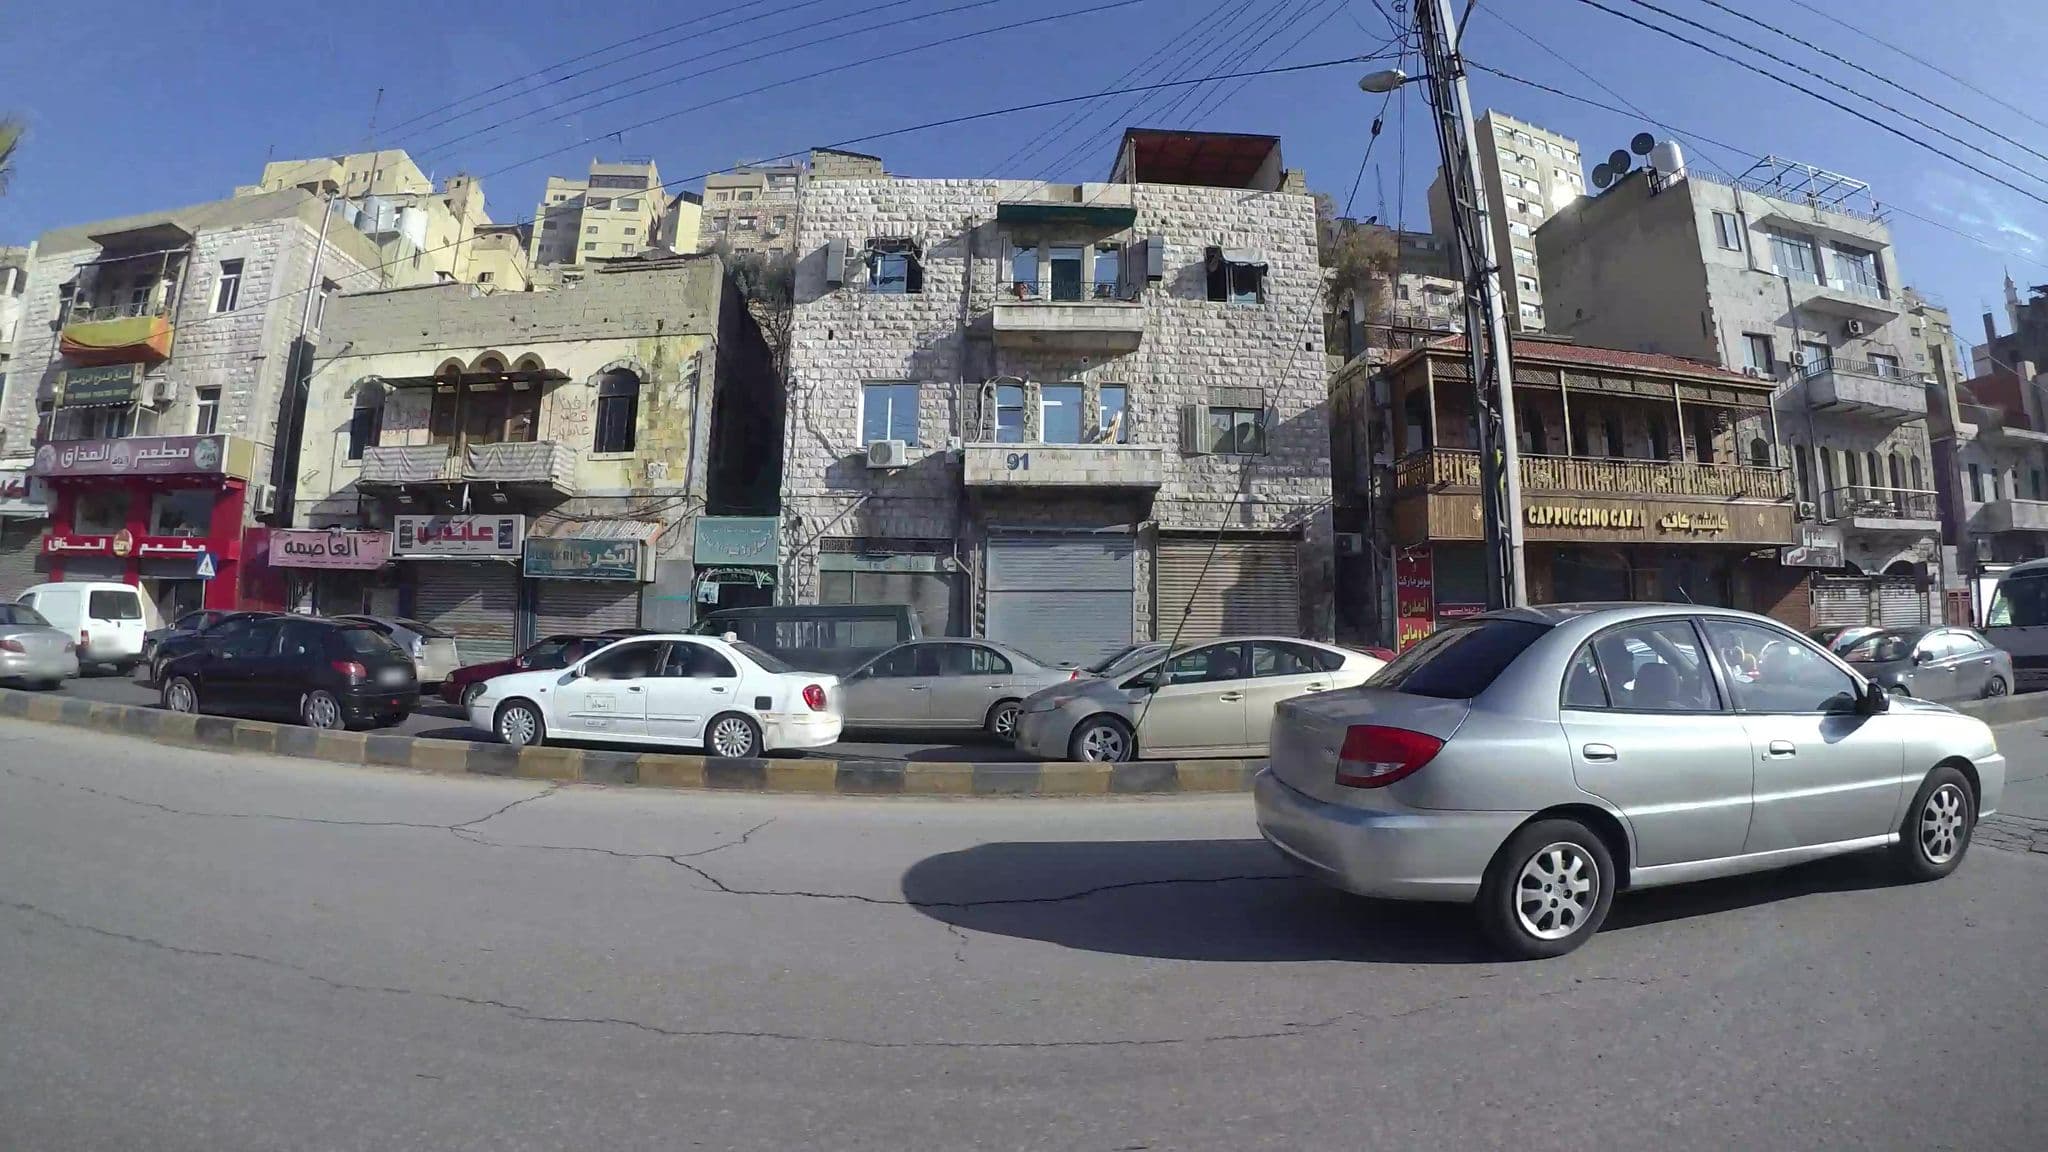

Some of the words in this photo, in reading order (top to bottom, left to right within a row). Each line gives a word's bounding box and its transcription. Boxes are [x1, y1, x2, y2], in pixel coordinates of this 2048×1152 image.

[61, 445, 110, 468] المذاق
[134, 441, 190, 468] مطعم
[1007, 453, 1029, 470] 91
[1528, 505, 1608, 527] CAPPUCCINO
